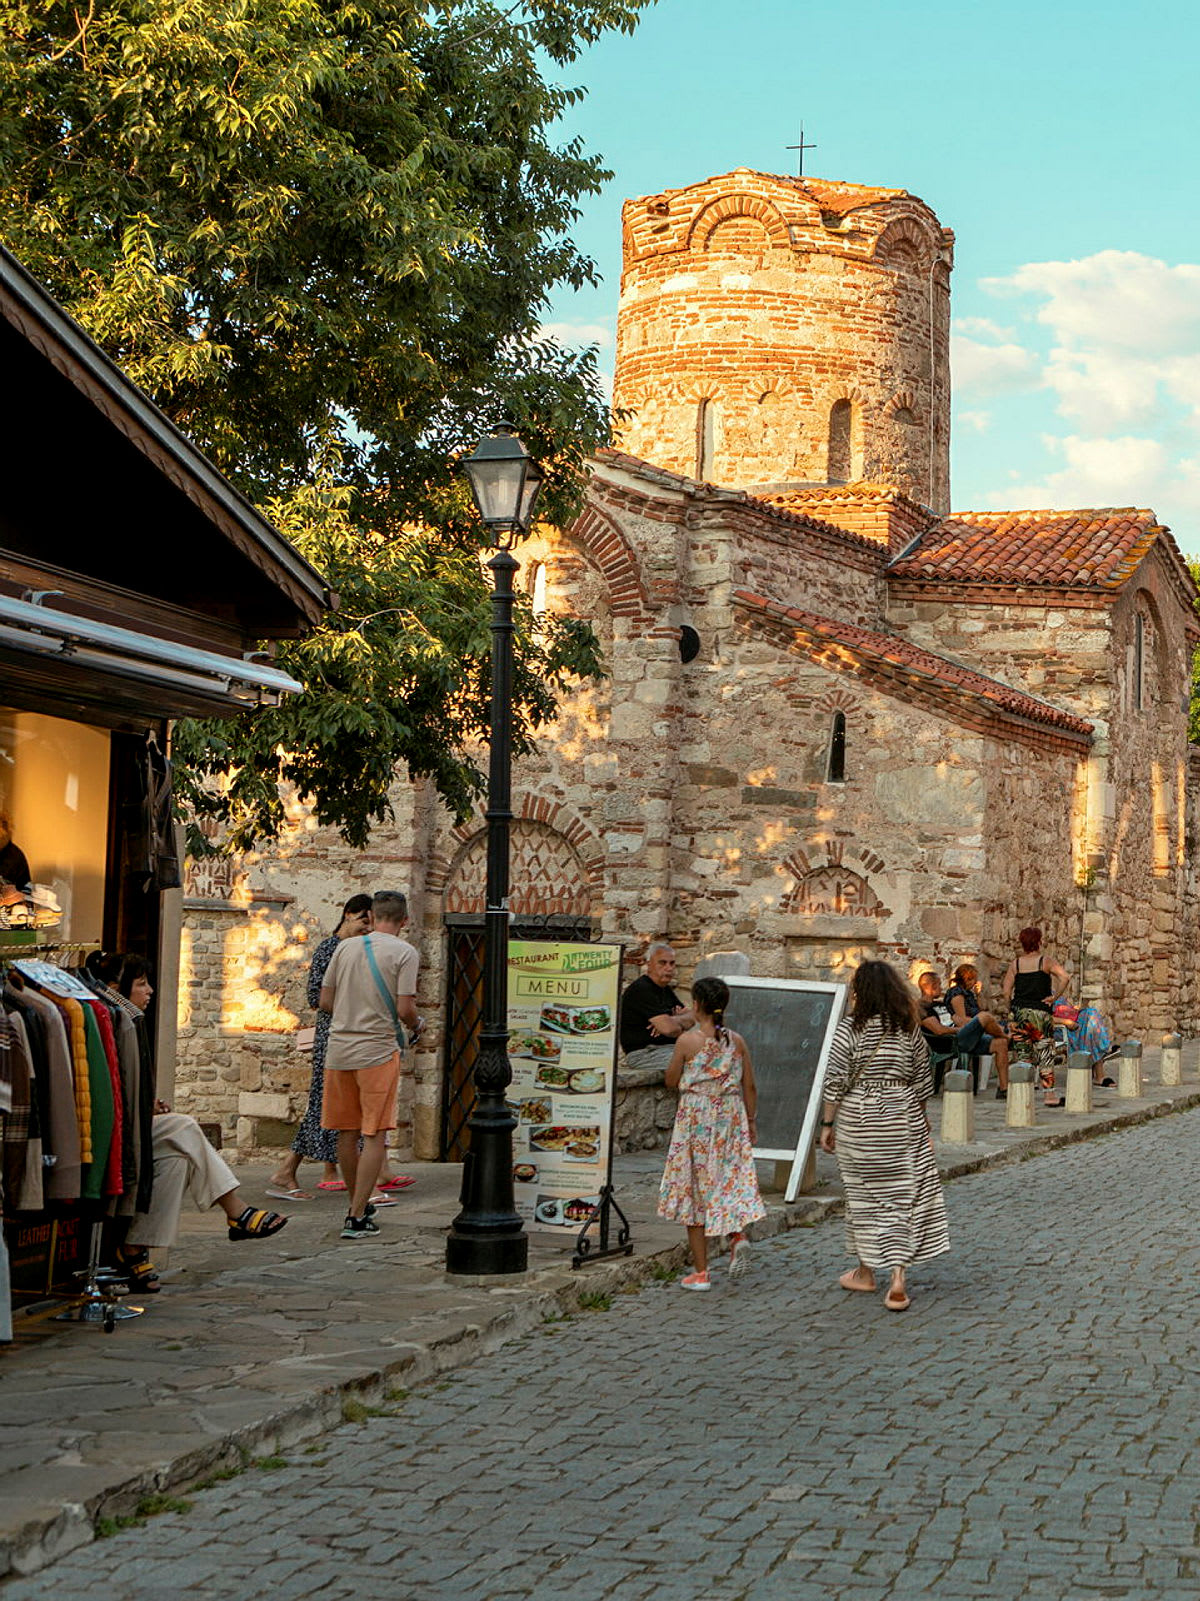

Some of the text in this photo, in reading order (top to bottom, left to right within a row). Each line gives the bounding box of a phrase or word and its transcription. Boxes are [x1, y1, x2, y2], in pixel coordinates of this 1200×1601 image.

[576, 950, 613, 961] TWENTY
[578, 958, 613, 970] FOUR
[528, 980, 581, 995] MENU
